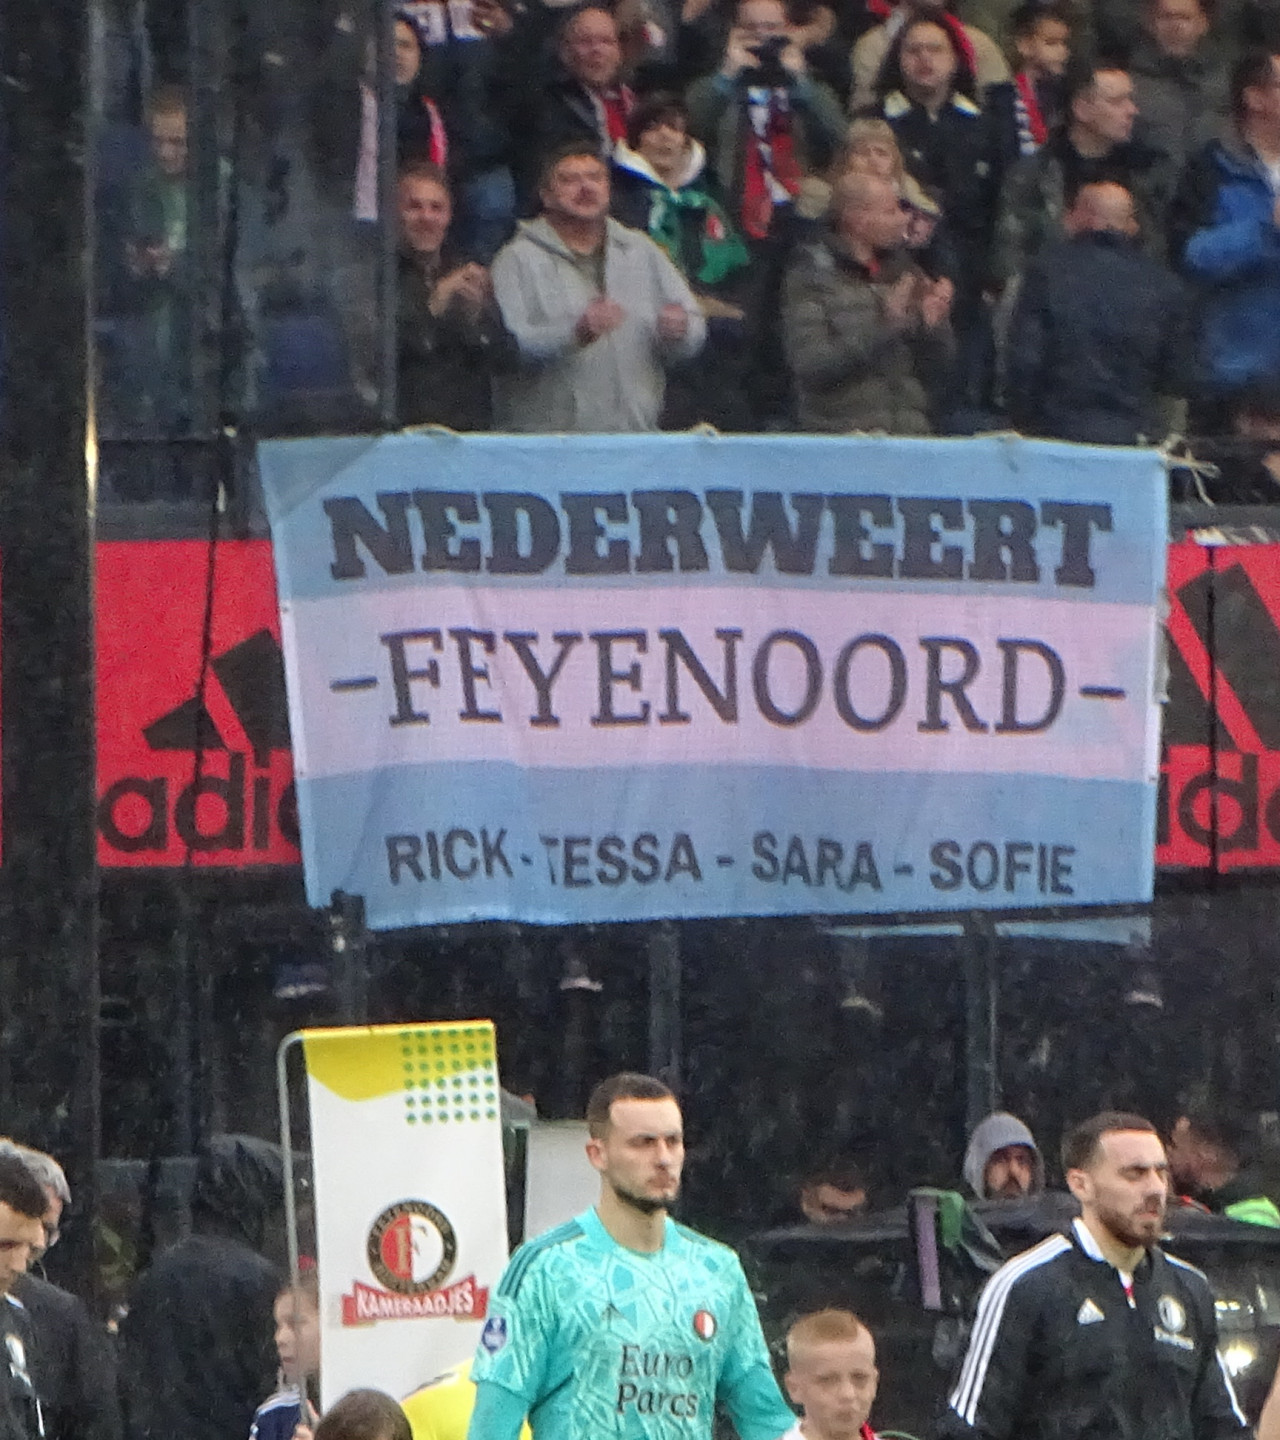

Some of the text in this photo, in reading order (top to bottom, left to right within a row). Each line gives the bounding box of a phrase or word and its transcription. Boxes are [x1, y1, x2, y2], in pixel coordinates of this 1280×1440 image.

[323, 487, 1114, 586] NEDERWEERT
[384, 828, 514, 887] RICK
[540, 832, 703, 889] TESSA
[751, 832, 884, 892] SARA
[928, 839, 1077, 895] SOFIE
[620, 1343, 694, 1380] Euro
[616, 1381, 699, 1419] Parcs
